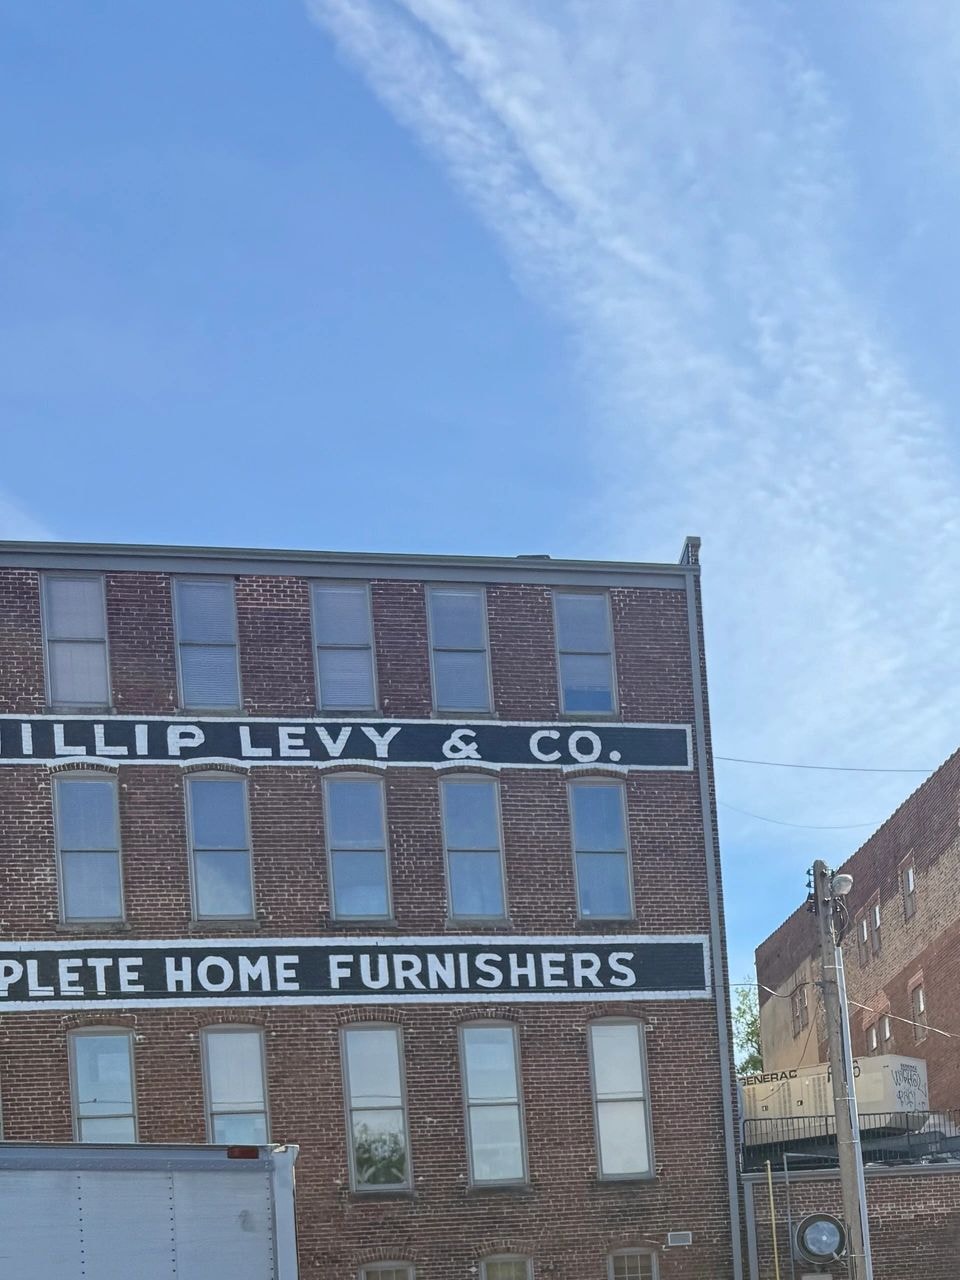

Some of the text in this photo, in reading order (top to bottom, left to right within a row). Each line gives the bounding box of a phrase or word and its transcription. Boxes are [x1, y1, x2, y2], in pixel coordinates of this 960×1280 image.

[239, 726, 402, 758] LEVY
[442, 728, 482, 759] &
[529, 729, 622, 763] CO.
[0, 951, 637, 997] PLETE HOME FURNISHERS
[739, 1069, 798, 1087] GENERAC
